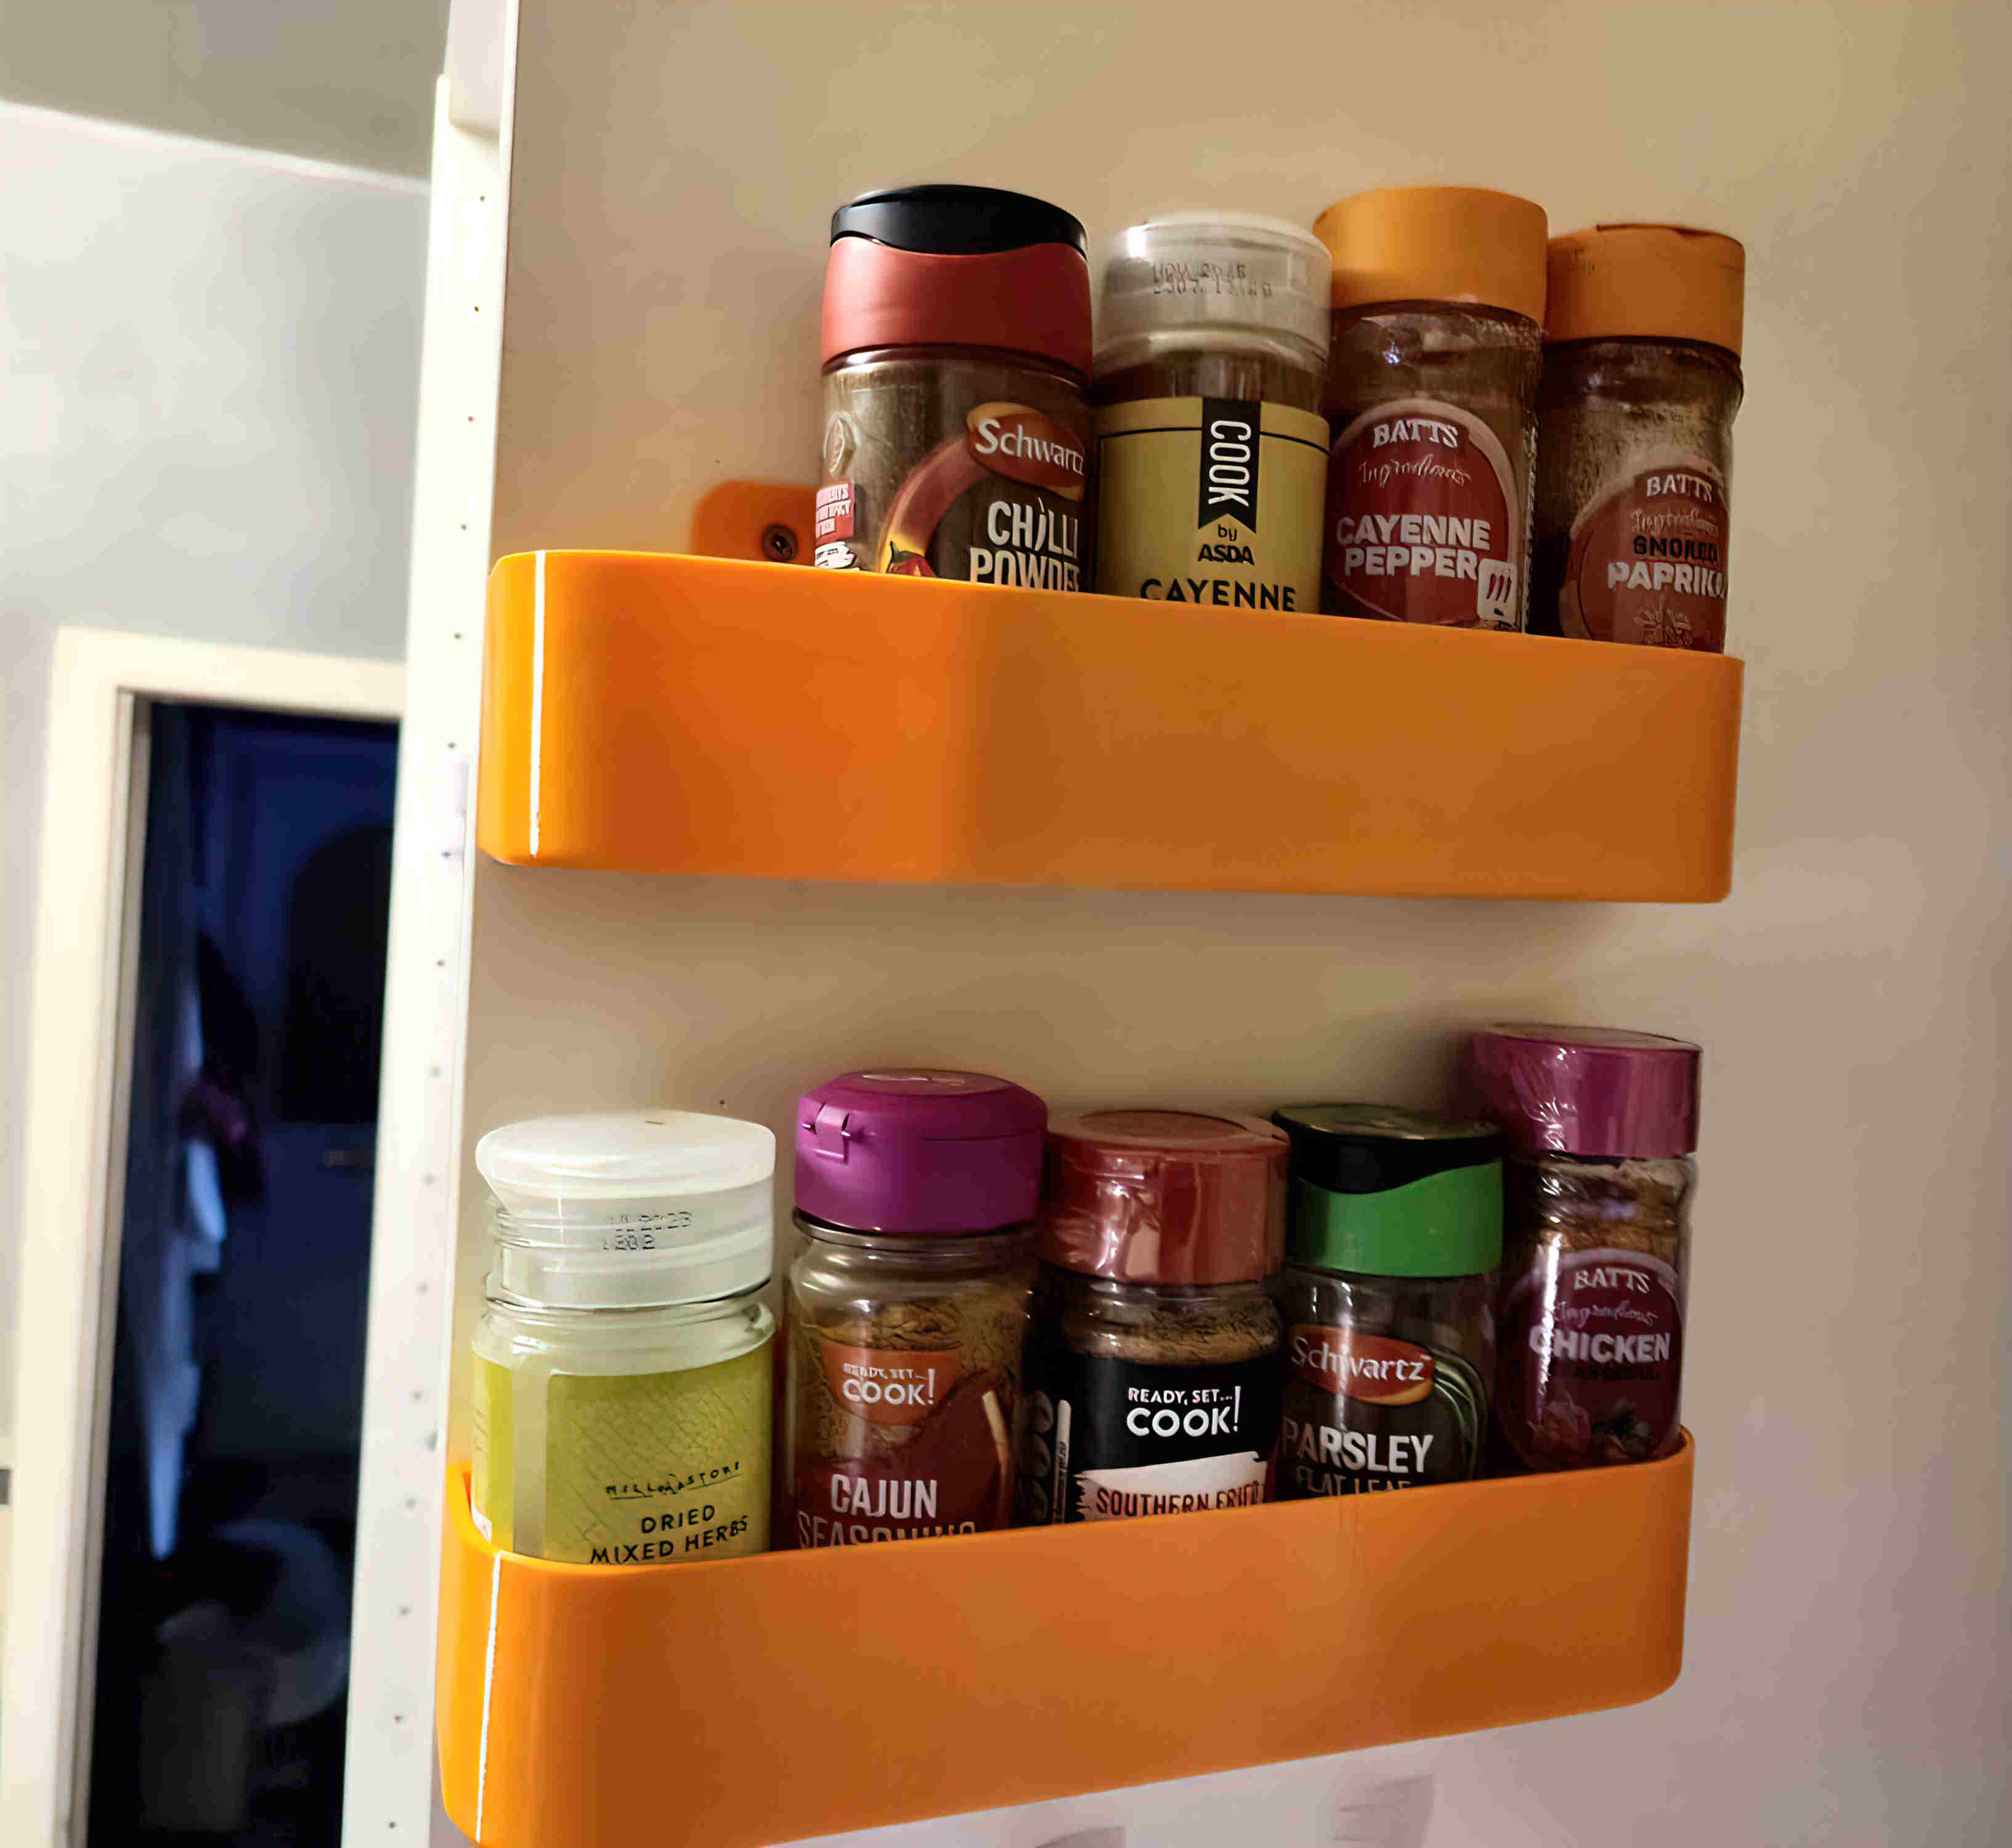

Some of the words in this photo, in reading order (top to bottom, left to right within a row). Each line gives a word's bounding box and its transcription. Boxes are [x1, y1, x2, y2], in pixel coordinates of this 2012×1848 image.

[1373, 419, 1459, 448] BATTS
[1208, 420, 1252, 508] COOK
[1217, 524, 1238, 542] by
[1336, 514, 1491, 551] CAYENNE
[1198, 544, 1255, 566] ASDA
[1345, 546, 1478, 582] PEPPER
[1140, 578, 1296, 612] CAYENNE
[1528, 1324, 1671, 1364] CHICKEN
[842, 1368, 936, 1406] COOK!
[1128, 1387, 1188, 1406] READY,
[1126, 1386, 1241, 1437] COOK!
[1281, 1416, 1434, 1473] PARSLEY
[831, 1473, 937, 1519] CAJUN
[641, 1505, 715, 1534] DRIED
[590, 1540, 674, 1564] MIXED
[684, 1515, 749, 1552] HERBS
